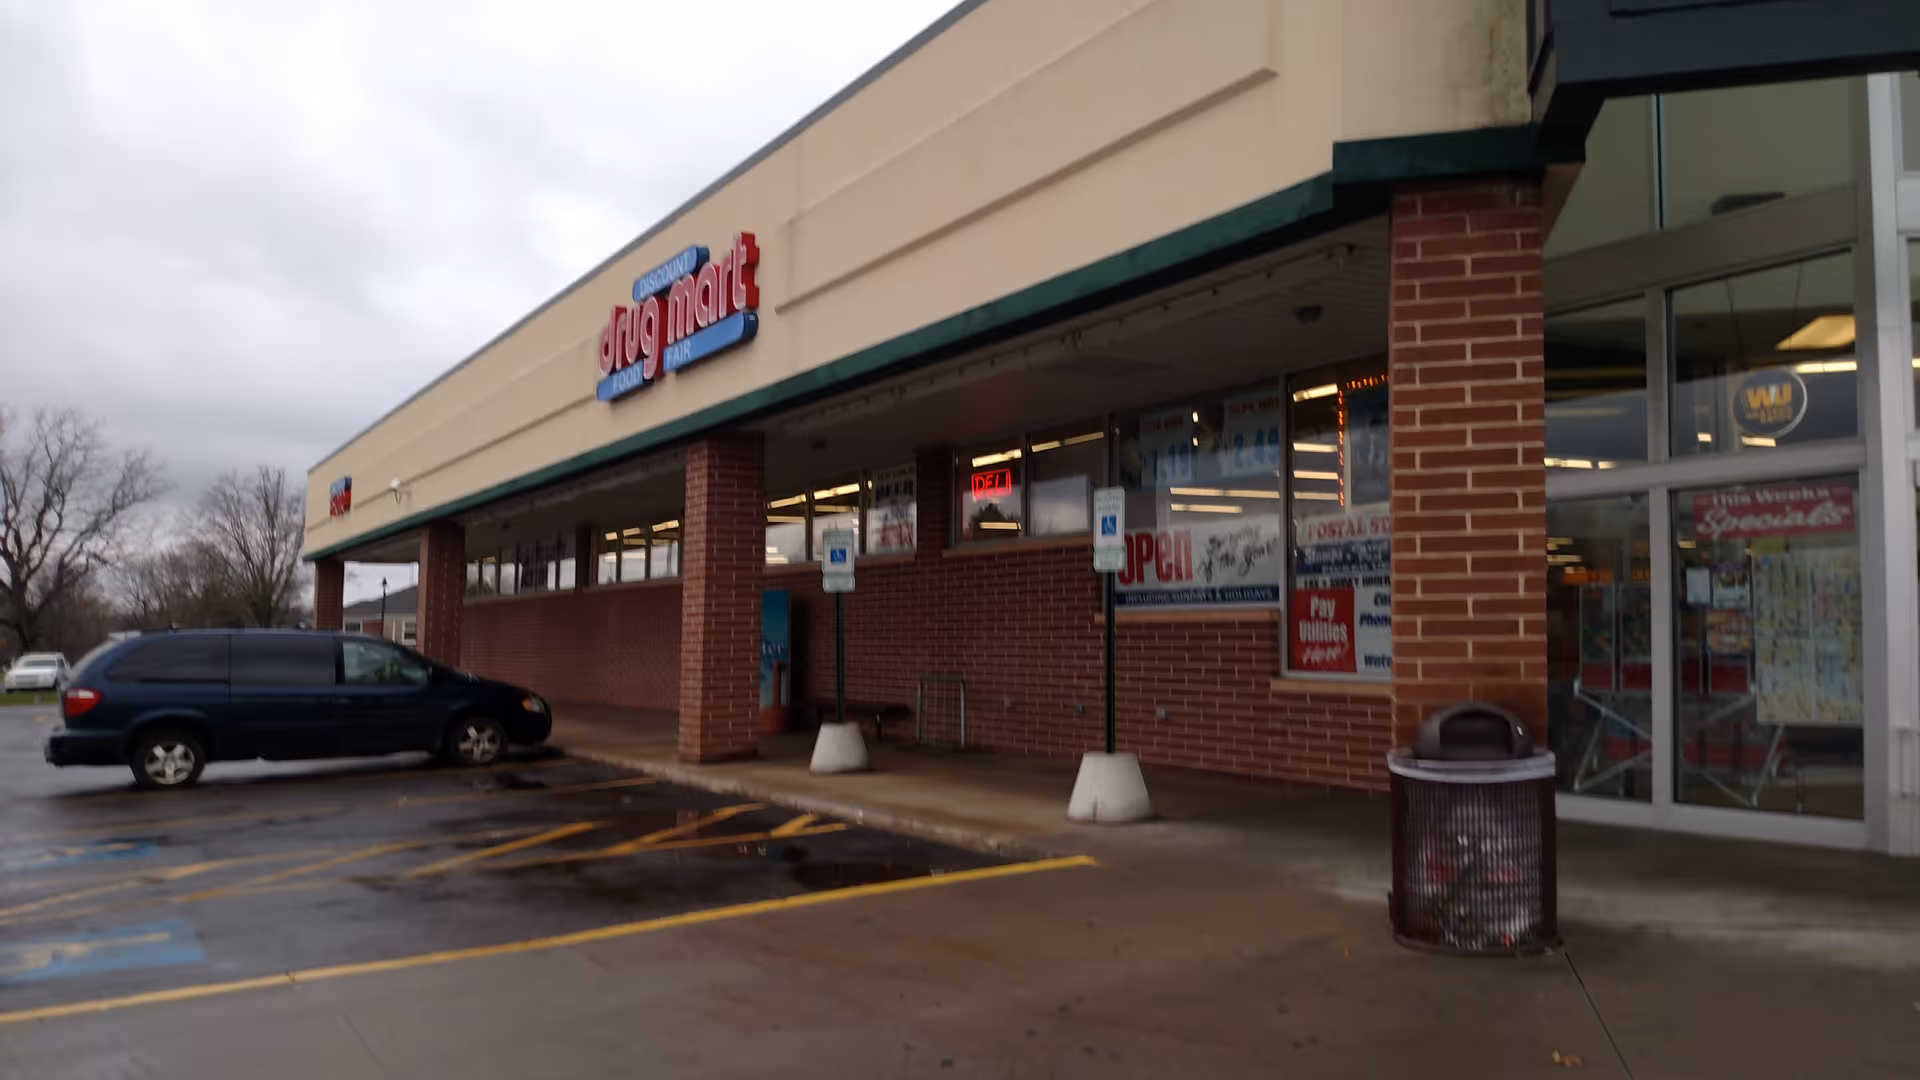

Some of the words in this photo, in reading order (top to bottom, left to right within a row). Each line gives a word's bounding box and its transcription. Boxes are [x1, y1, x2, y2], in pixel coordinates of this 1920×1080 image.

[638, 250, 691, 299] DISCOUNT
[599, 294, 664, 380] drug
[667, 232, 758, 345] mart
[665, 340, 692, 366] FAIR
[612, 366, 641, 393] FOOD
[974, 472, 1009, 499] DELI
[1308, 514, 1368, 541] POSTAL
[1697, 501, 1849, 538] Specials
[1310, 595, 1336, 622] Pay
[1299, 619, 1348, 643] Utilities
